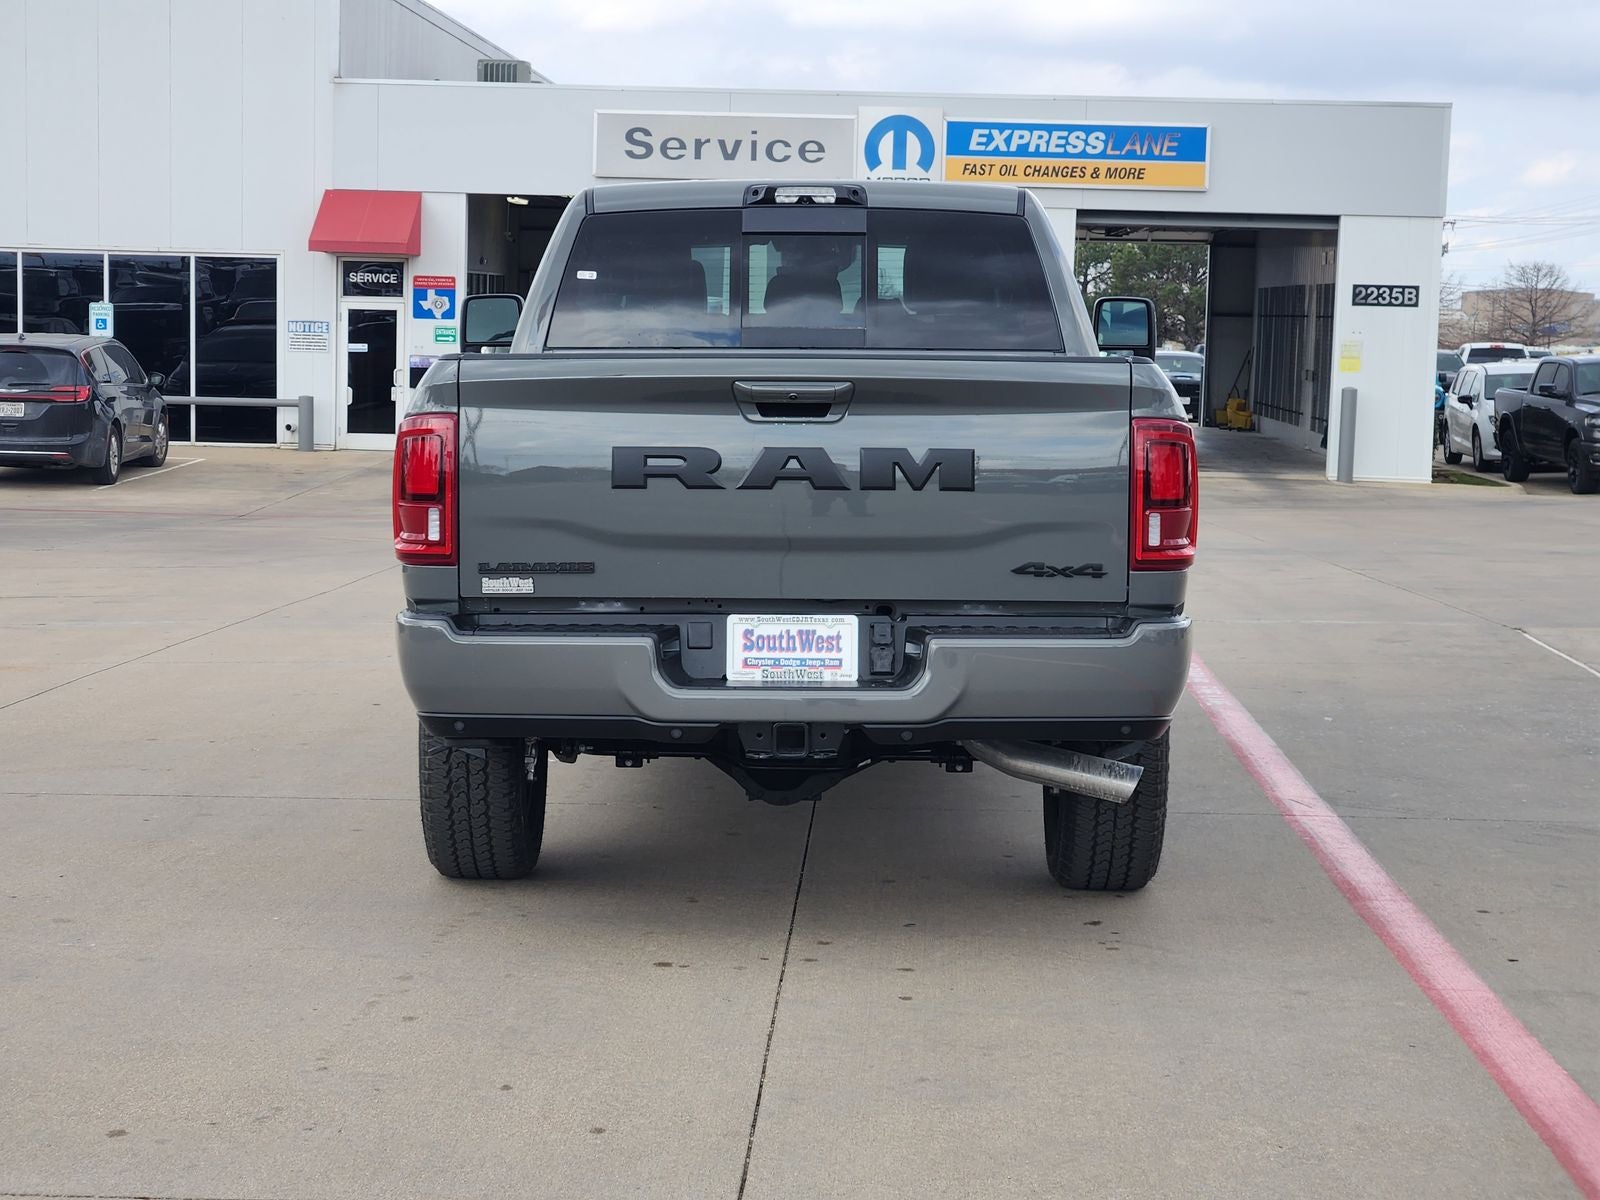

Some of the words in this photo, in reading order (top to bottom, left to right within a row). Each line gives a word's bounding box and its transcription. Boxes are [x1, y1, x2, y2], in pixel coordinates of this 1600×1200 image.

[624, 126, 826, 164] Service
[962, 163, 995, 177] FAST
[999, 164, 1019, 177] OIL
[1023, 165, 1086, 179] CHANGES
[1090, 166, 1101, 179] &
[1104, 166, 1146, 180] MORE
[349, 272, 398, 284] SERVICE
[1355, 286, 1417, 305] 2235B
[288, 321, 329, 333] NOTICE
[611, 446, 976, 492] RAM
[478, 562, 595, 574] LARAMIE
[482, 577, 534, 588] SouthWest
[742, 628, 842, 653] SouthWest
[747, 658, 774, 666] Chrysler
[780, 658, 800, 667] Dodge
[805, 658, 821, 667] Jeep
[824, 658, 840, 666] Ram
[761, 669, 823, 679] SouthWest
